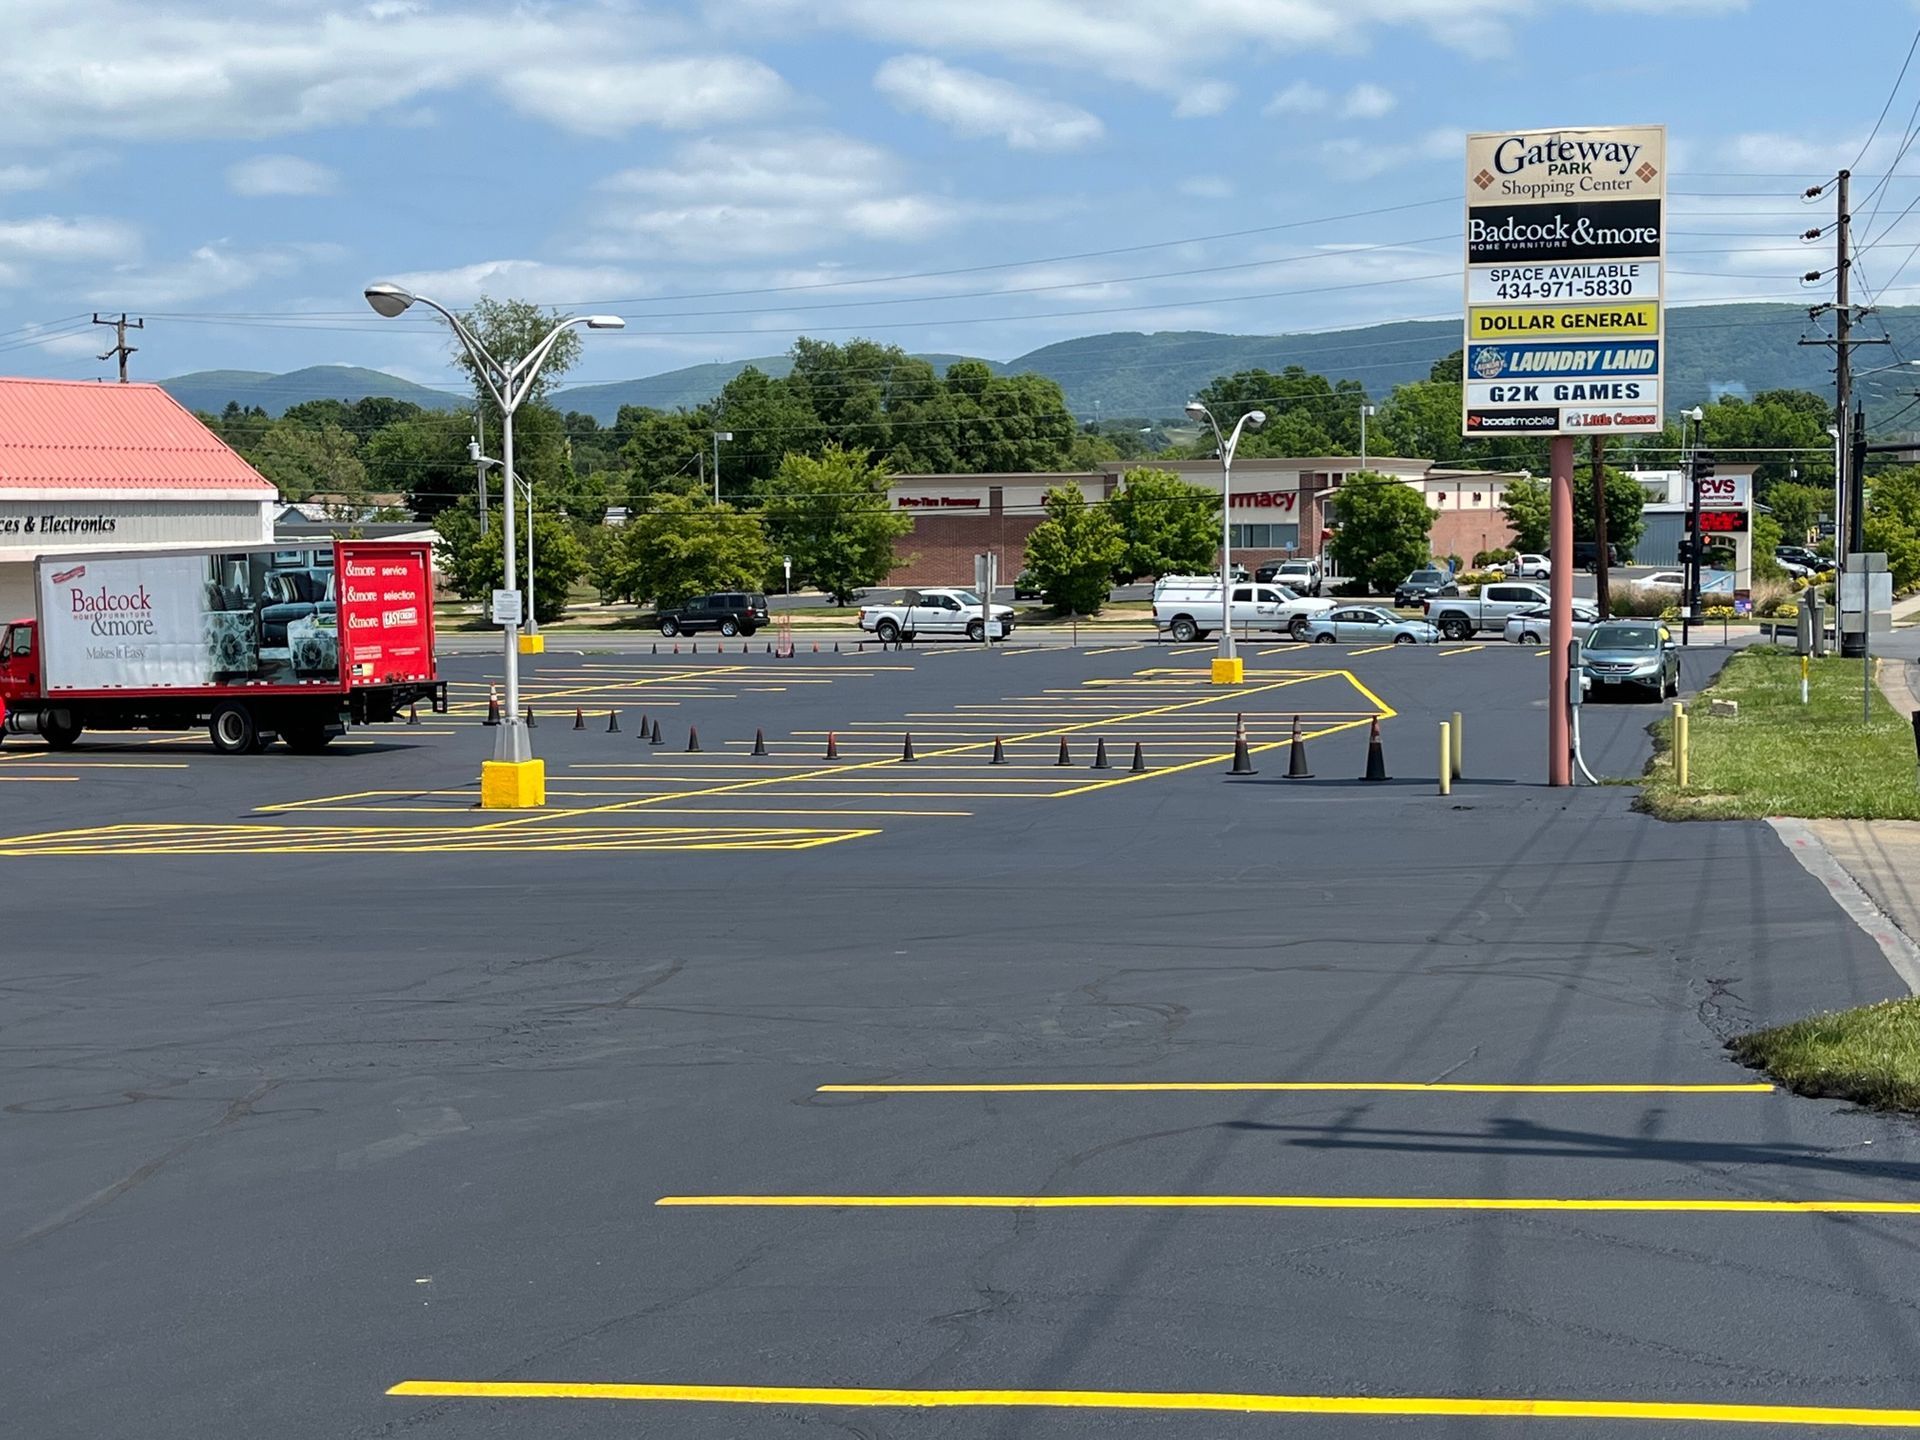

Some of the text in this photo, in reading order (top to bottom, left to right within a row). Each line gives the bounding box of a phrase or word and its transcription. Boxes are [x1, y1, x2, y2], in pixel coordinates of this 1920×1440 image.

[1494, 136, 1641, 175] Gateway
[1547, 162, 1593, 176] PARK
[1501, 176, 1633, 198] Shopping Center
[1470, 240, 1568, 251] HOME FURNITURE
[1490, 264, 1640, 282] SPACE AVAILABLE
[1496, 279, 1633, 299] 434-971-5830
[1480, 312, 1648, 331] DOLLAR GENERAL
[1509, 349, 1656, 372] LAUNDRY LAND
[1489, 383, 1641, 402] G2K GAMES
[1582, 413, 1612, 427] Little
[1700, 479, 1736, 494] CVS
[1229, 491, 1297, 512] rmacy
[24, 516, 35, 532] &
[40, 514, 117, 534] Electronics
[345, 560, 408, 577] &more service
[70, 584, 152, 613] Badcock
[347, 585, 416, 603] &more selection
[91, 612, 154, 637] &more
[103, 612, 152, 620] FURNITURE
[348, 612, 379, 629] &more
[86, 646, 116, 660] Makes
[124, 646, 146, 661] Easy
